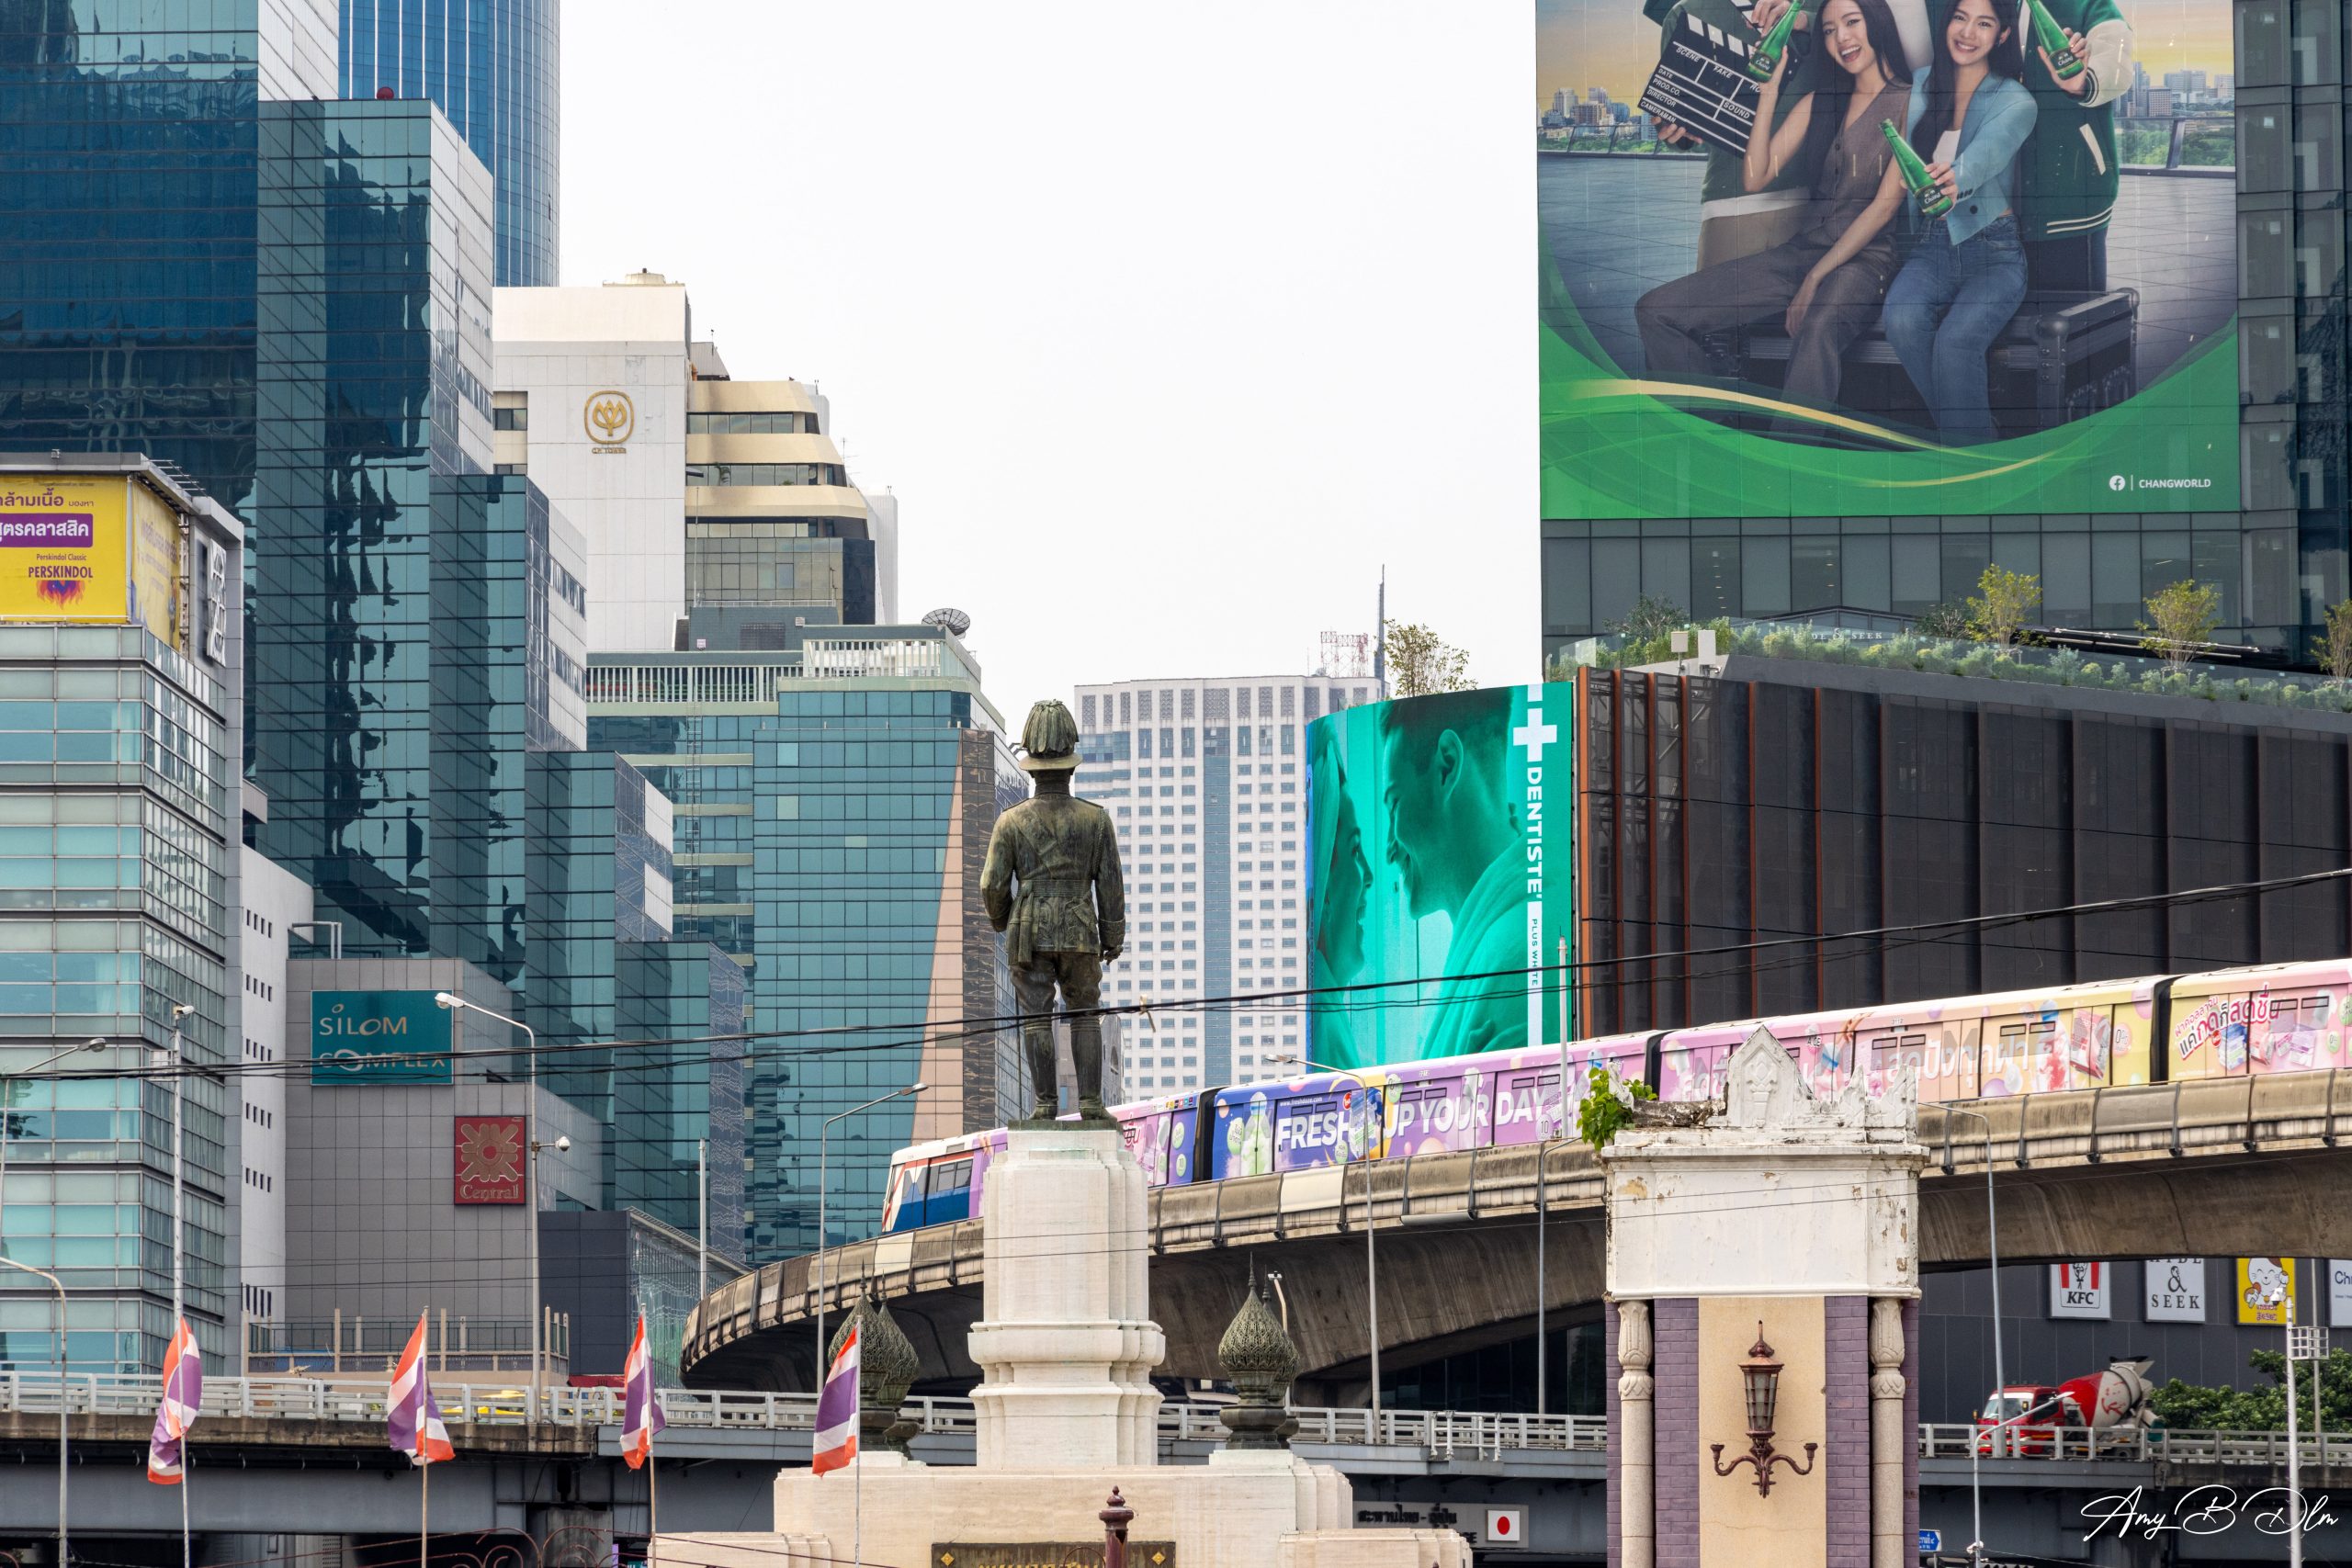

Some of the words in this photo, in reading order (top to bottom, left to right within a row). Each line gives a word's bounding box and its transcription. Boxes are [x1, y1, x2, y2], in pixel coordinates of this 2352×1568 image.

[1676, 47, 1700, 63] SCENE
[1657, 69, 1673, 80] DATE
[1646, 88, 1677, 107] DIRECTOR
[1640, 101, 1677, 123] CAMERAMAN
[1723, 101, 1750, 119] SOUND
[2139, 479, 2211, 489] CHANGWORLD
[0, 520, 89, 542] ตรคลาสสิค
[28, 566, 93, 578] PERSKINDOL
[319, 1003, 407, 1036] SILOM
[1276, 1111, 1352, 1152] FRESH
[1383, 1102, 1415, 1138] UP
[1419, 1094, 1490, 1134] YOUR
[1495, 1087, 1547, 1125] DAY
[460, 1184, 519, 1201] Central
[2335, 1270, 2352, 1285] Ch
[2067, 1291, 2095, 1305] KFC
[2151, 1293, 2200, 1309] SEEK
